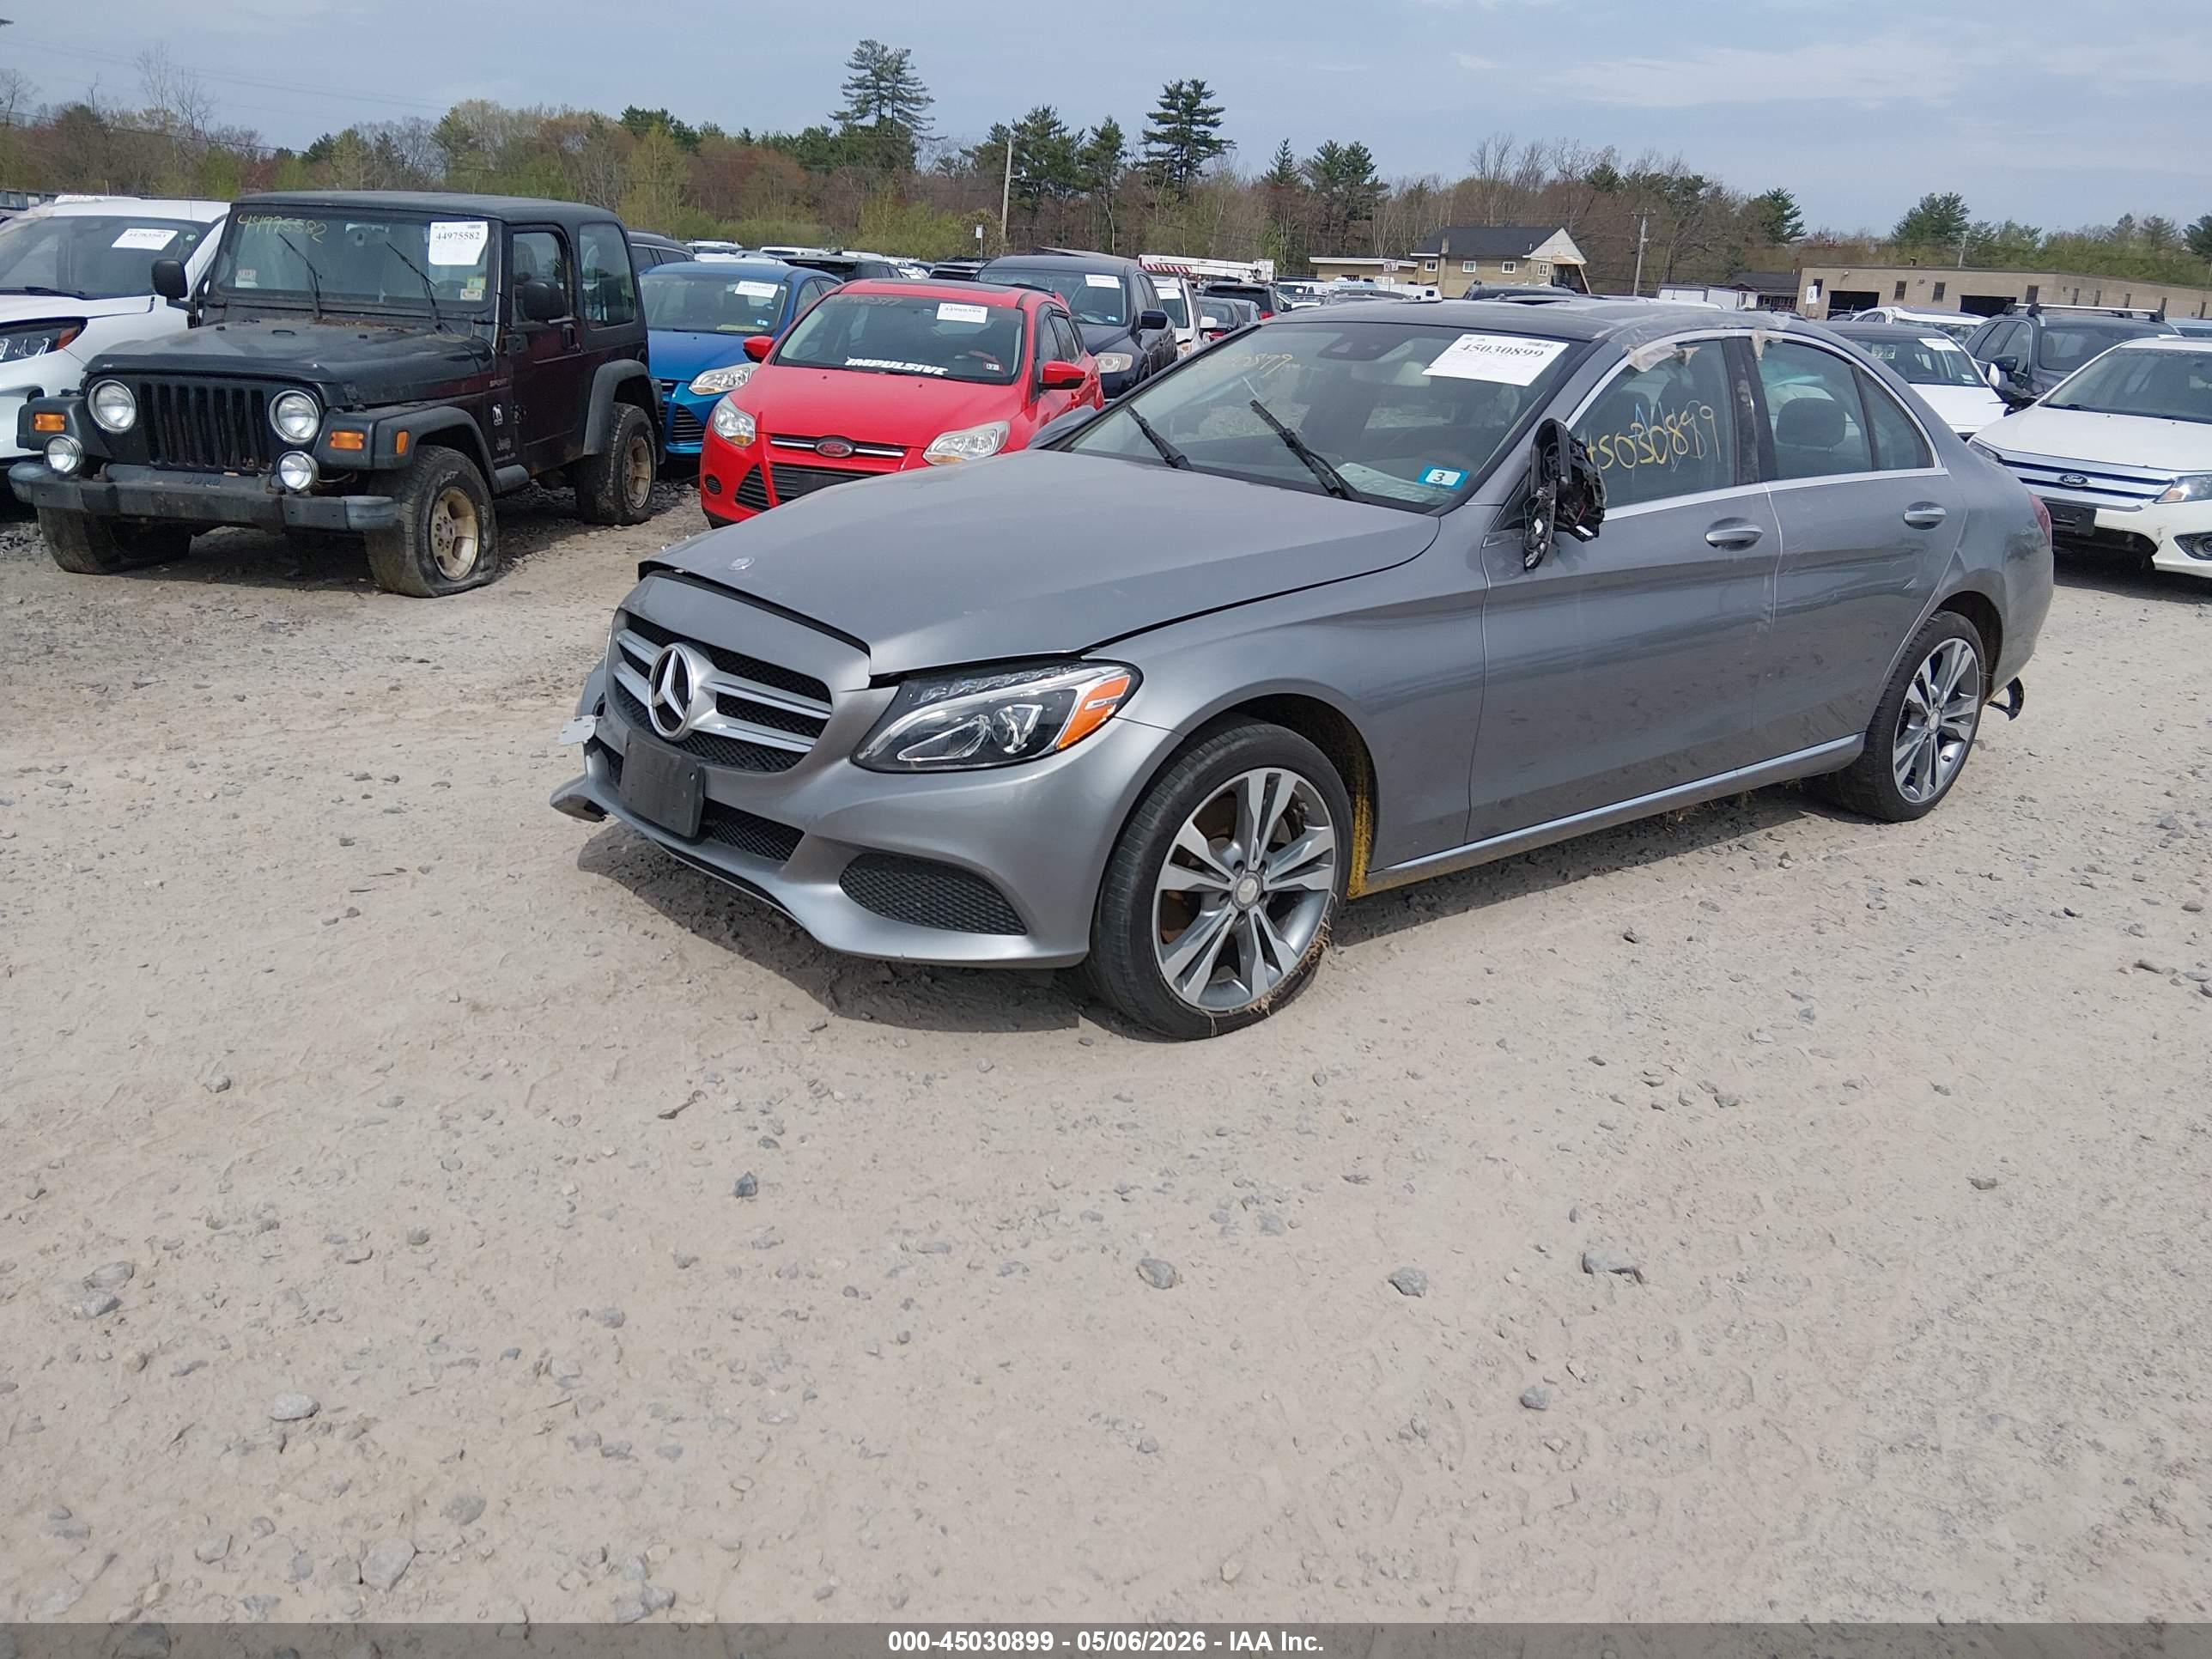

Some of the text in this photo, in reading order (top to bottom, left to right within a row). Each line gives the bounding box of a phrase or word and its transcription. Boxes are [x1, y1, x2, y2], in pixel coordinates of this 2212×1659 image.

[435, 231, 481, 241] 44975582
[1461, 343, 1545, 359] 45030899
[845, 356, 948, 376] IMPULSIVE
[1432, 471, 1446, 483] 3
